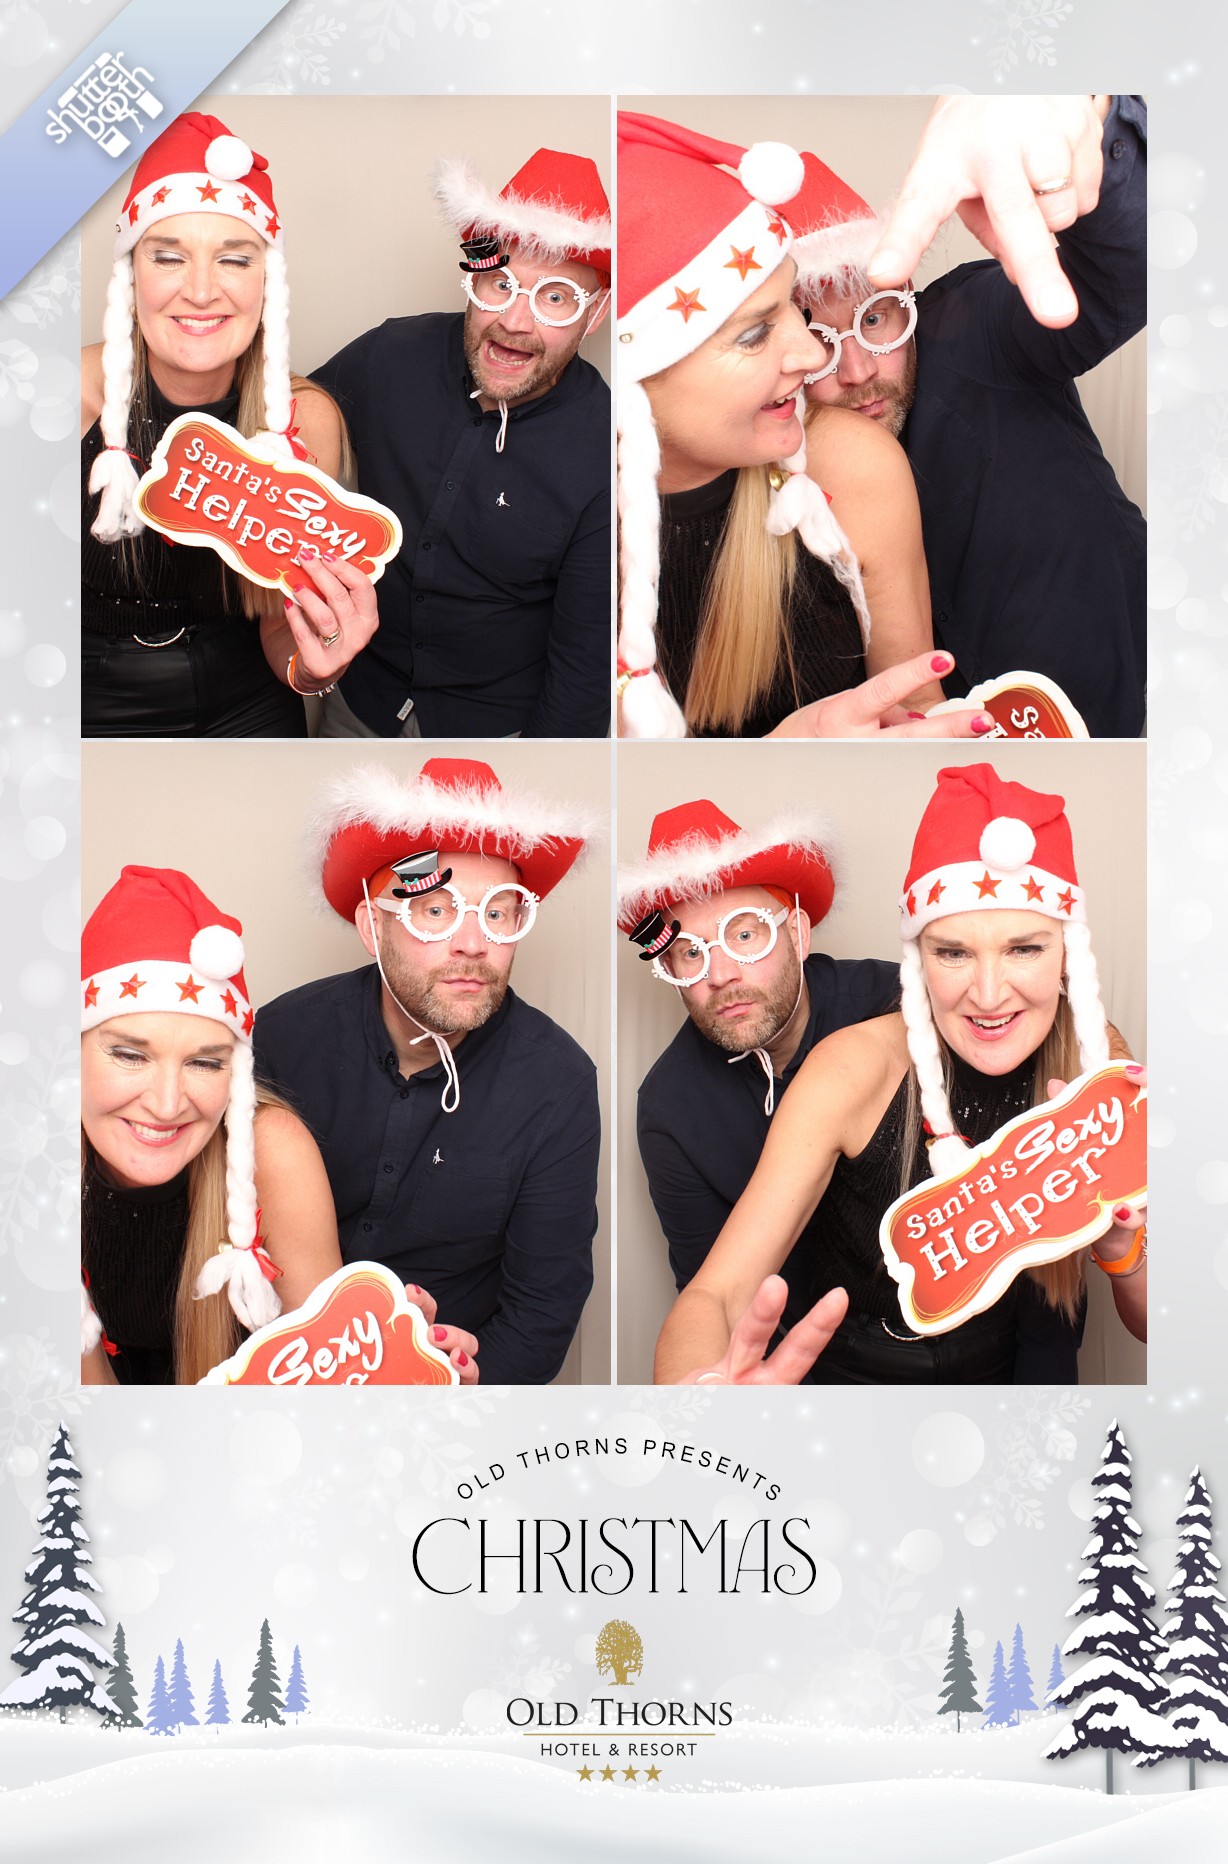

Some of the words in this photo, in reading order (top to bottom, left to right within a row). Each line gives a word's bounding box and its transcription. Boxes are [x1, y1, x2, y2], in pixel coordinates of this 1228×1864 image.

[184, 437, 282, 504] Santa's
[275, 488, 367, 561] Sexy
[906, 1158, 1018, 1240] Santa's
[1013, 1096, 1125, 1176] Sexy
[919, 1146, 1107, 1282] Helper
[267, 1310, 384, 1385] Sexy
